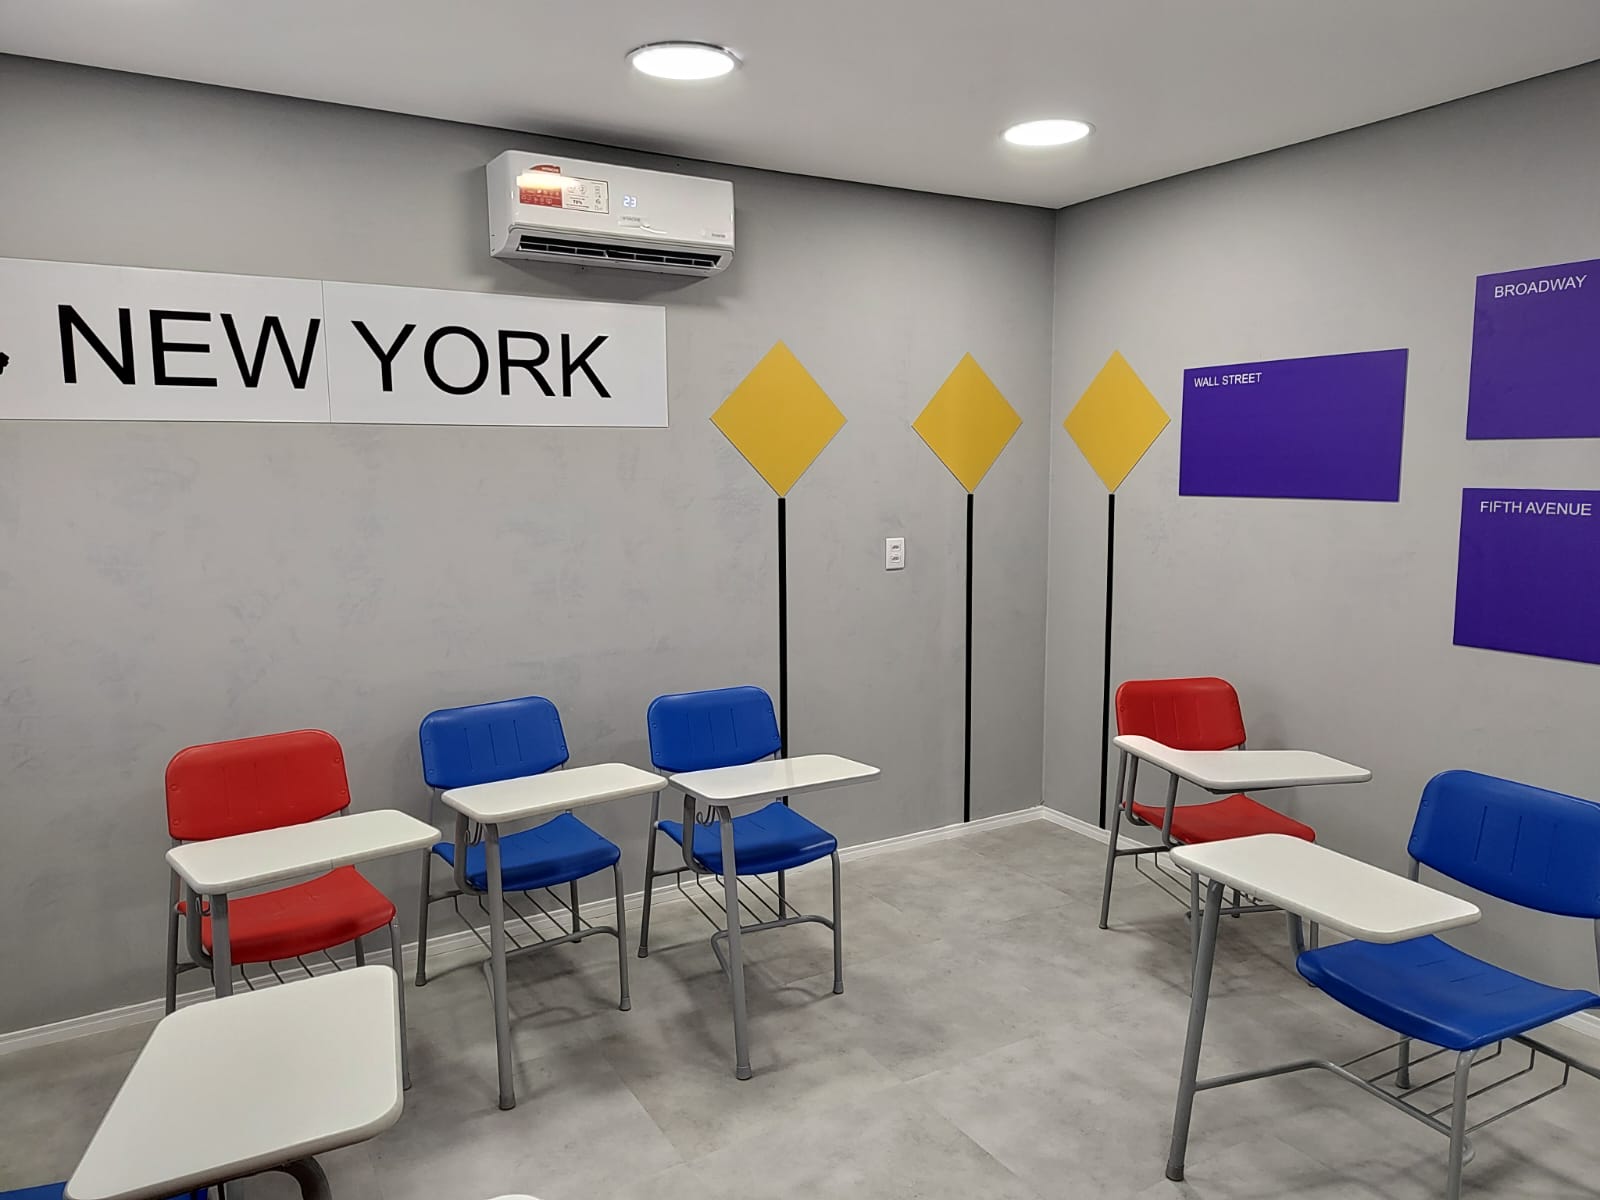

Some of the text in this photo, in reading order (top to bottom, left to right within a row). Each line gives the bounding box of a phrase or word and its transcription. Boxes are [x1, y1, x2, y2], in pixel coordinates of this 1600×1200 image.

[623, 195, 637, 208] 23
[1494, 275, 1588, 298] BROADWAY
[57, 303, 612, 400] NEW YORK
[1193, 372, 1262, 388] WALL STREET
[1479, 500, 1593, 517] FIFTH AVENUE
